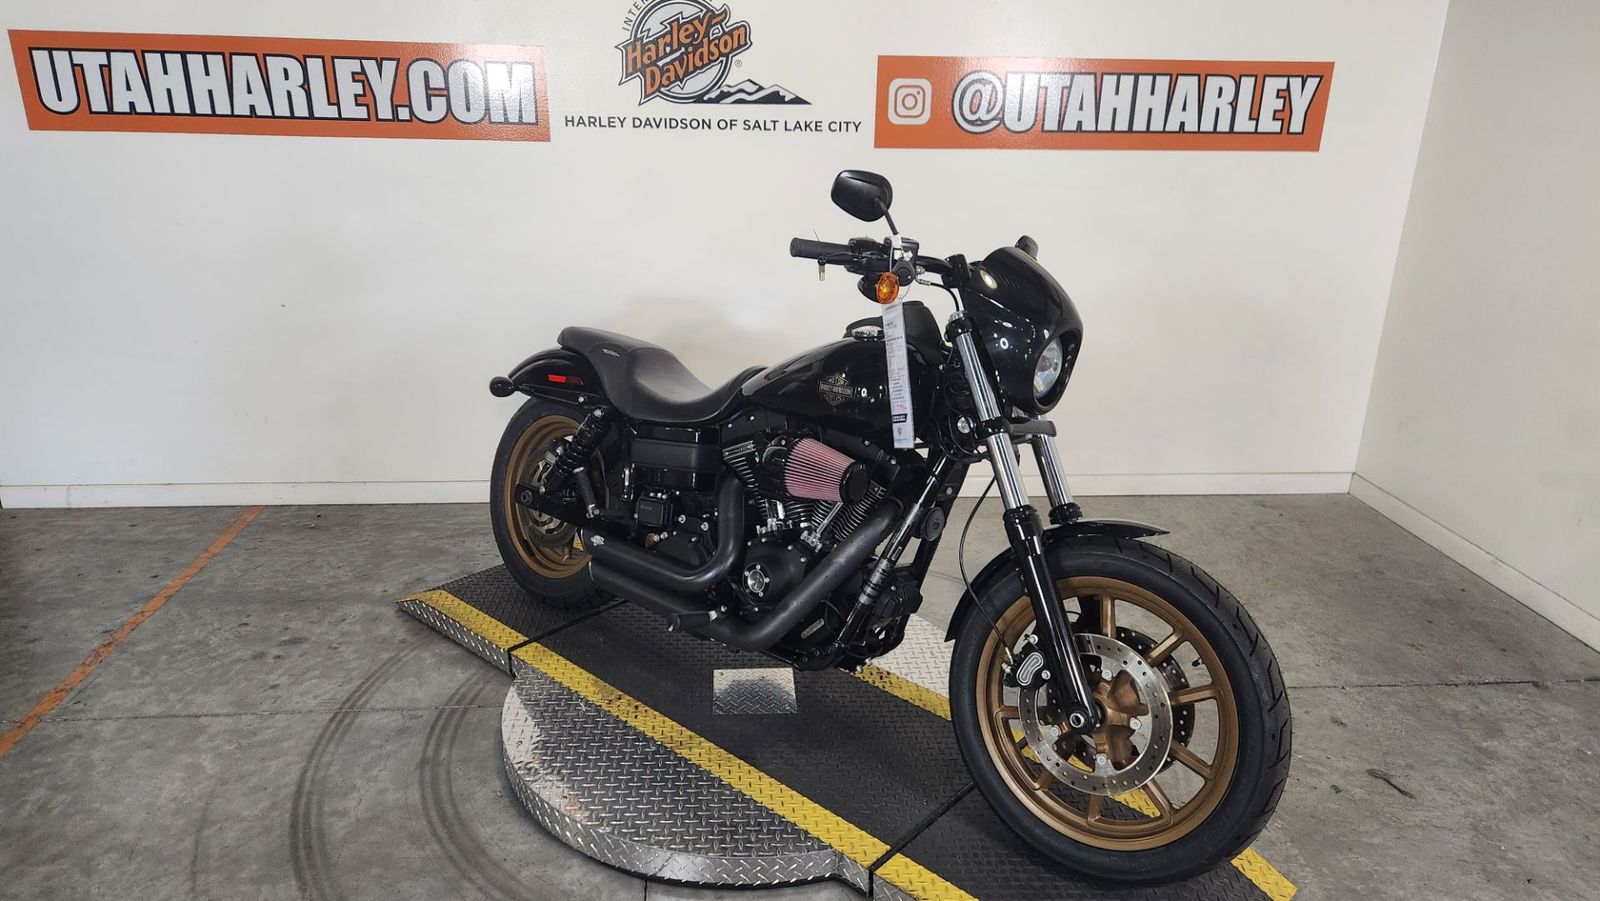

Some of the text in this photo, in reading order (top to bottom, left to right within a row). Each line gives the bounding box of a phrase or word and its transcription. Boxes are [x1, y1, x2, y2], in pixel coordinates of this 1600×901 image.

[28, 47, 537, 125] UTAHHARLEY.COM
[645, 26, 745, 96] Davidson
[564, 115, 862, 133] HARLEY DAVIDSON OF SALT LAKE CITY
[951, 70, 1324, 135] @UTAHHARLEY
